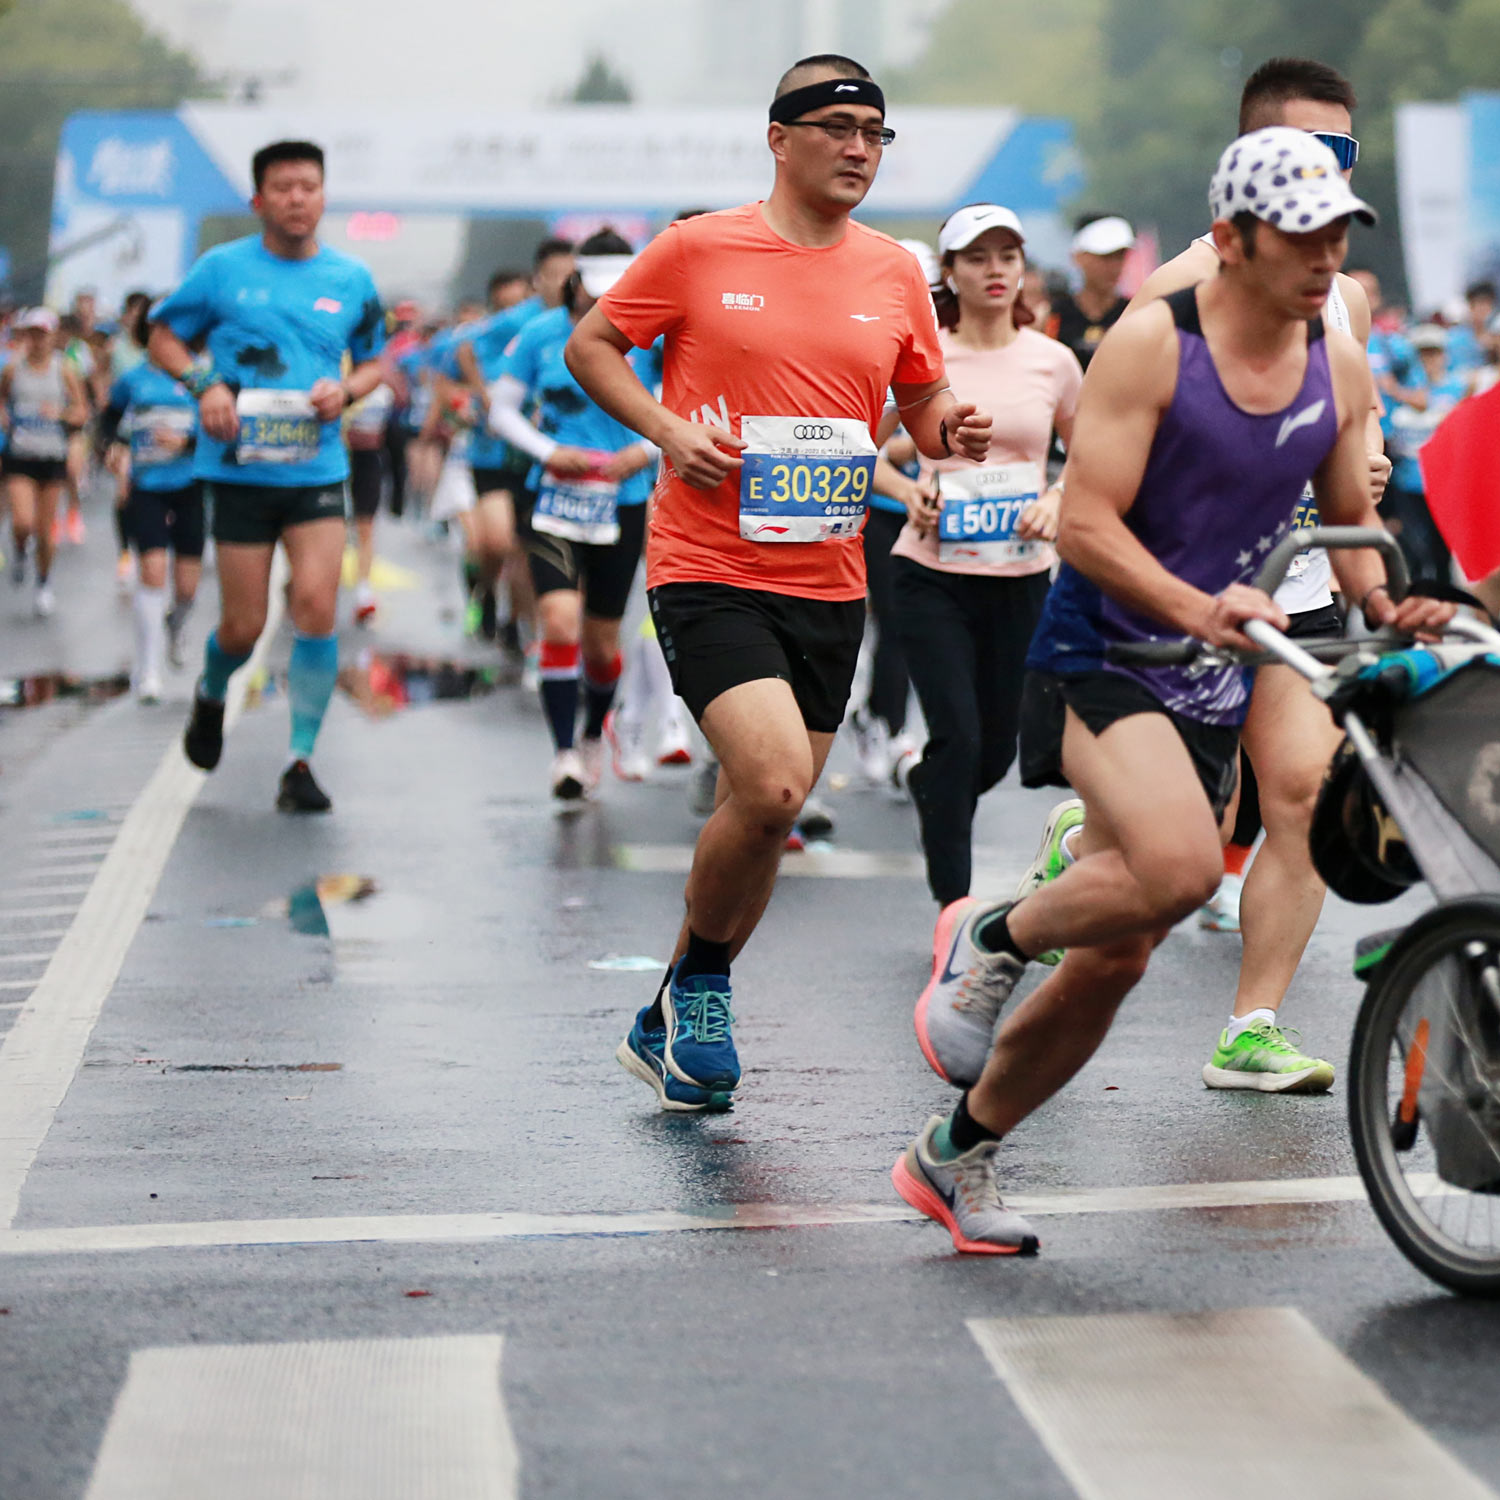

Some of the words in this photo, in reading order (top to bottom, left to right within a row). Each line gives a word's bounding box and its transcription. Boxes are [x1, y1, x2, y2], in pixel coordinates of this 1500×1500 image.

[721, 292, 764, 307] 喜临门
[750, 477, 764, 499] E
[770, 464, 868, 503] 30329
[946, 513, 961, 534] E
